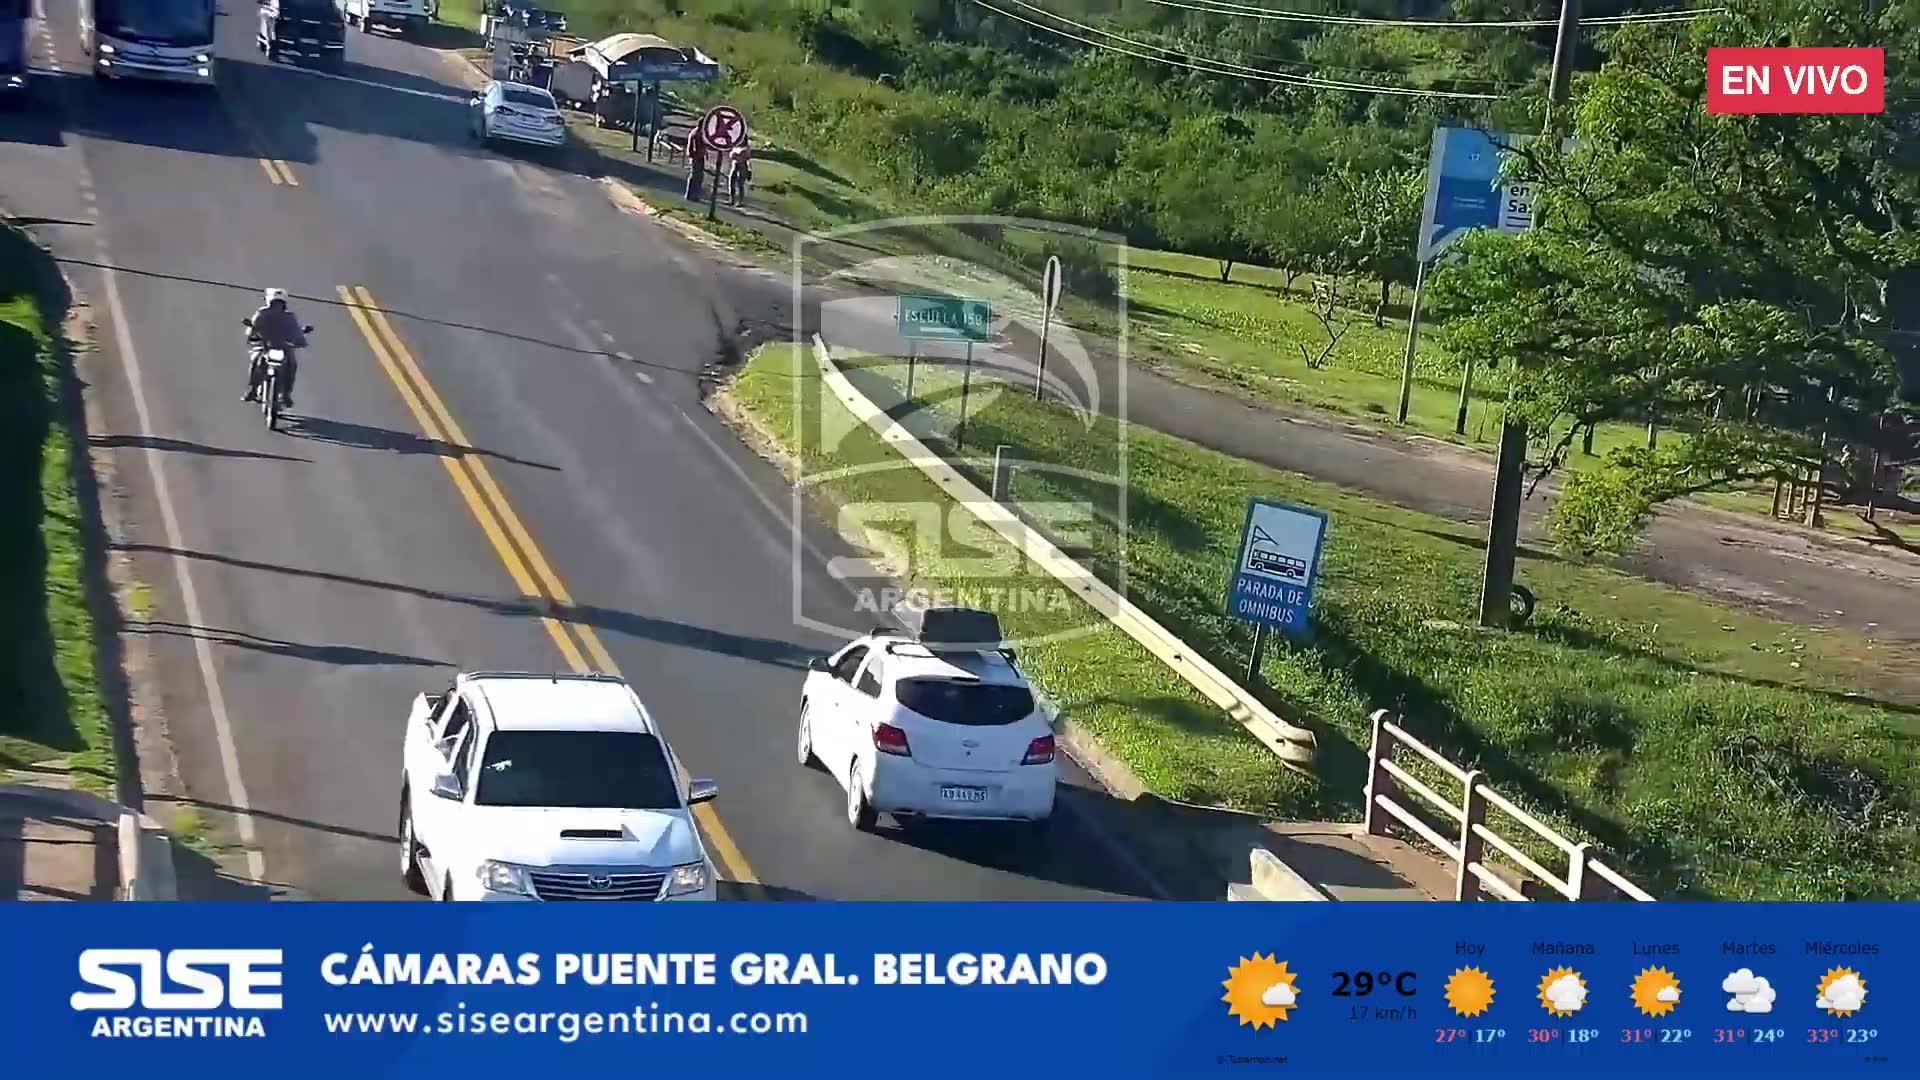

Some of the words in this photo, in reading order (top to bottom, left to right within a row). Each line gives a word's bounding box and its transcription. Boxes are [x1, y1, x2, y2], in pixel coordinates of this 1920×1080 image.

[1236, 578, 1284, 602] PARADA
[1287, 589, 1305, 607] DE
[1238, 599, 1295, 624] OMNIBUS
